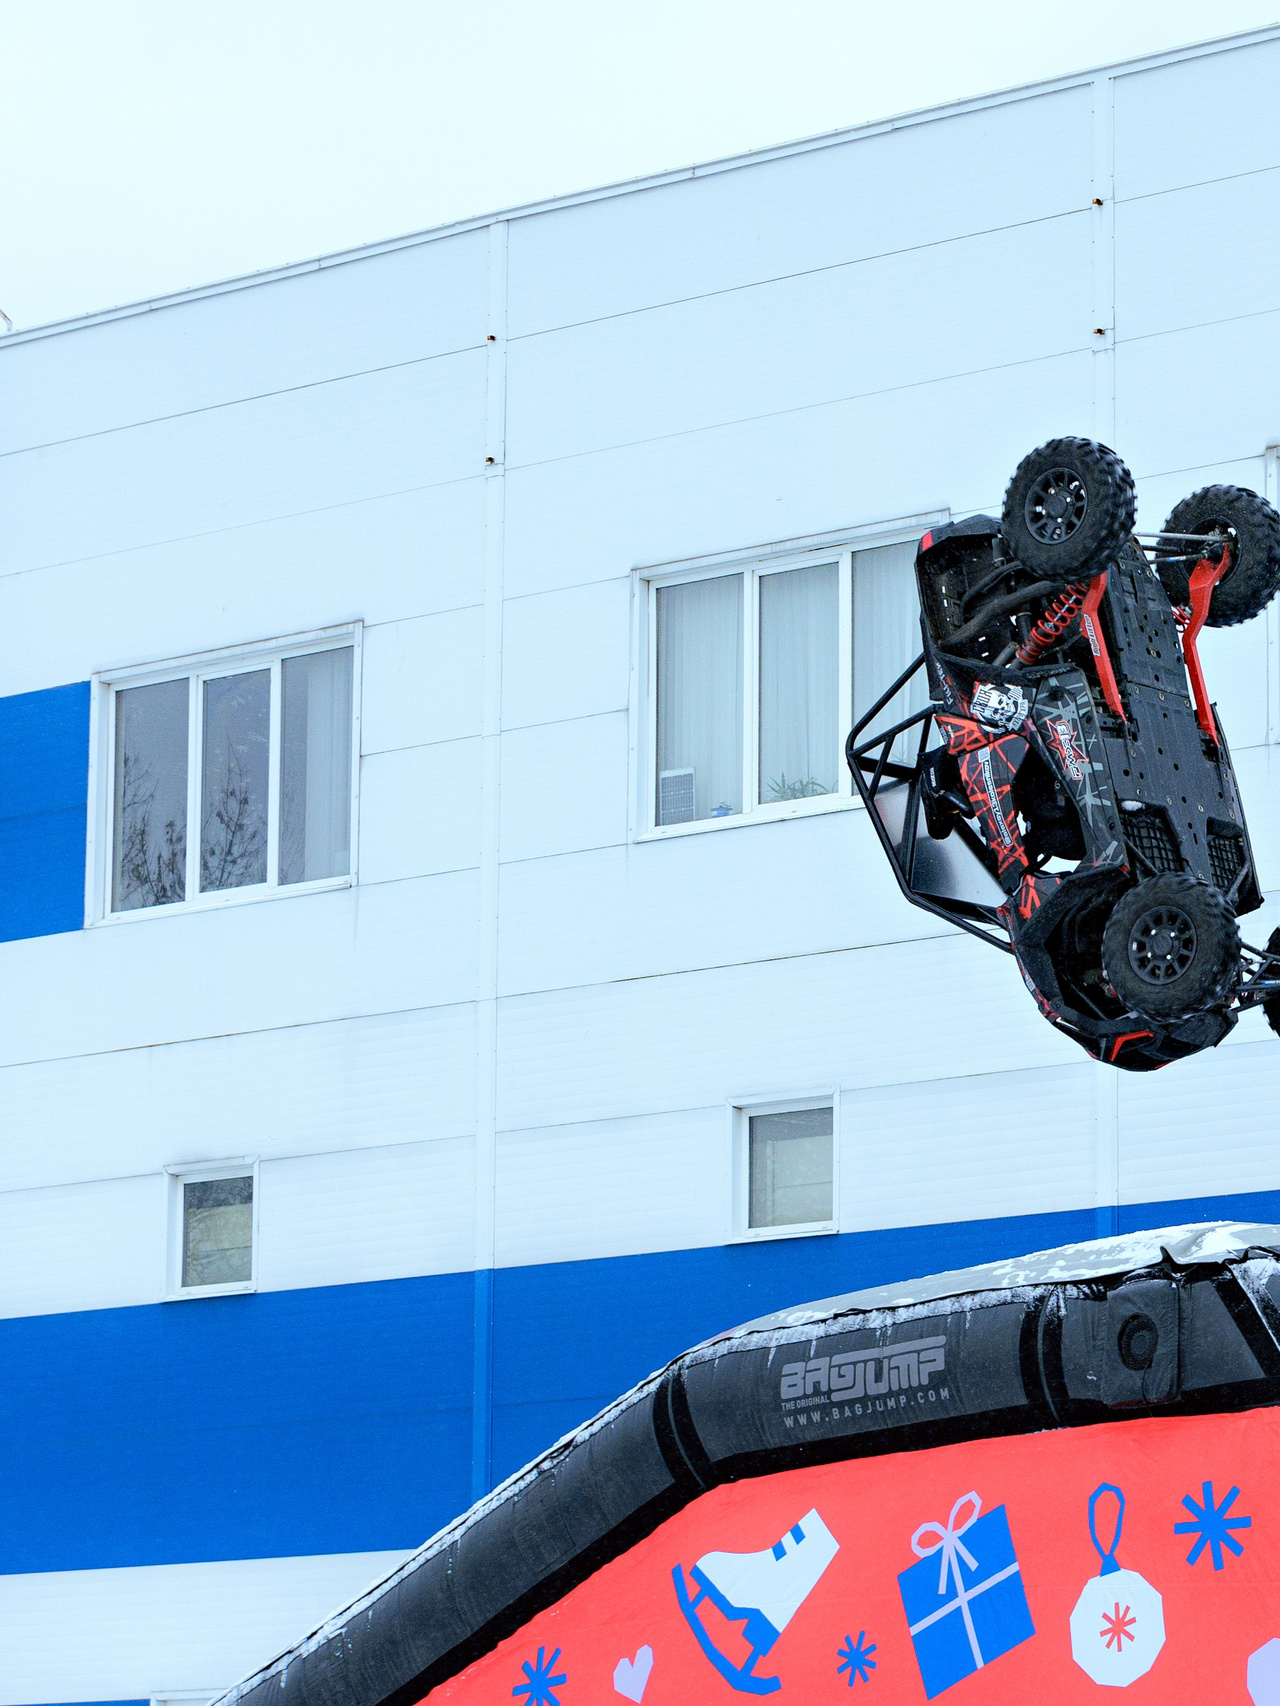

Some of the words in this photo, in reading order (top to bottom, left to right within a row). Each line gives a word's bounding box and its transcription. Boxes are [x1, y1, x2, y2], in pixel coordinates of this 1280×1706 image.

[780, 1335, 947, 1402] BAGJUMP
[781, 1401, 796, 1411] THE
[797, 1395, 830, 1409] ORIGINAL
[783, 1388, 950, 1429] WWW.BAGJUMP.COM
